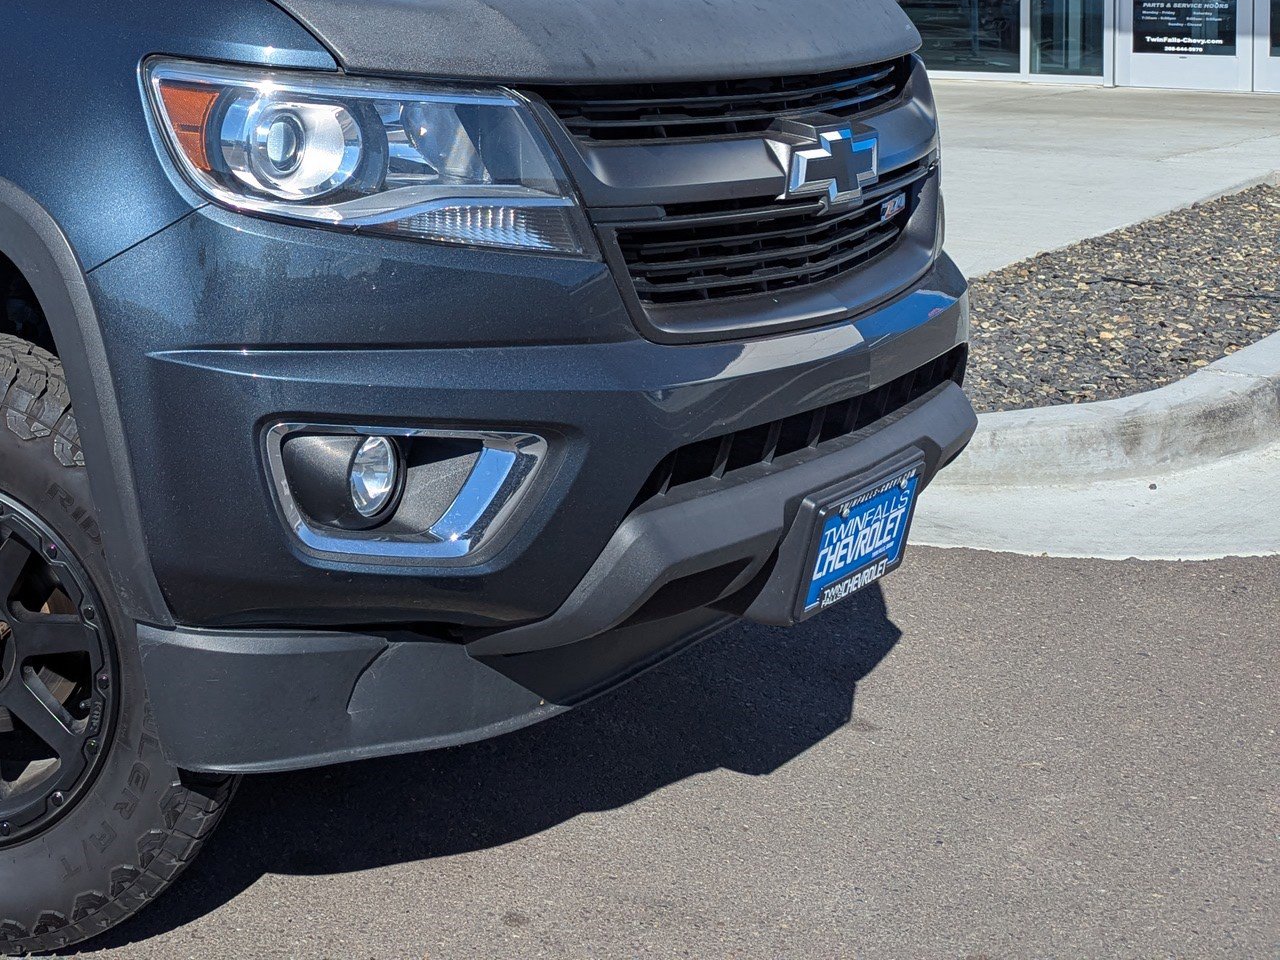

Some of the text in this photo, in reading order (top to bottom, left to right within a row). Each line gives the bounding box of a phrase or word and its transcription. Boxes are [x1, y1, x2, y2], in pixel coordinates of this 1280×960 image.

[812, 506, 906, 581] CHEVROLET
[824, 490, 910, 547] TWINFALLS
[841, 558, 889, 597] CHEVROLET
